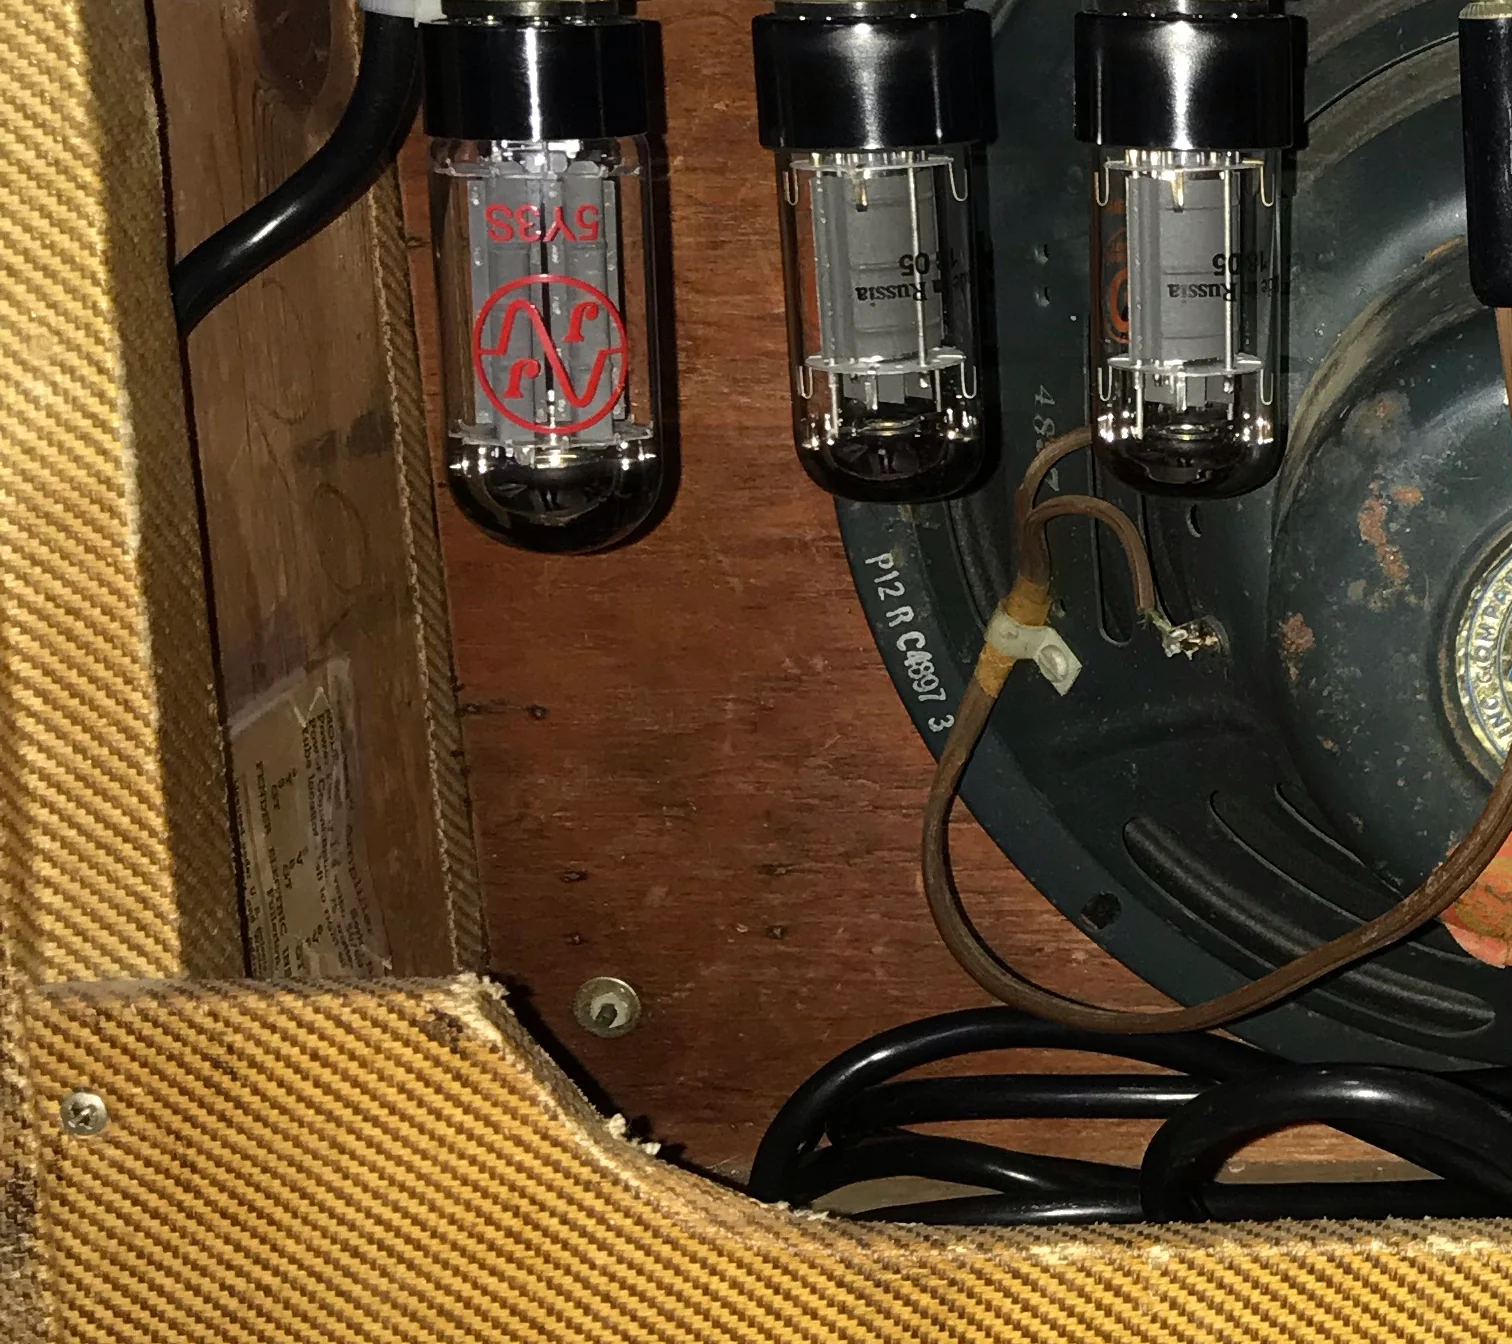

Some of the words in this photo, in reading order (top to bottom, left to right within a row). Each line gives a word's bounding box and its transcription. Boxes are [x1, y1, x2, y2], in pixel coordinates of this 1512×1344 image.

[484, 203, 598, 242] 5Y3S
[854, 281, 927, 306] Russia
[1167, 282, 1236, 303] Russia
[864, 552, 906, 601] P12
[253, 760, 274, 835] FENDER
[266, 846, 290, 936] ELECTRIC
